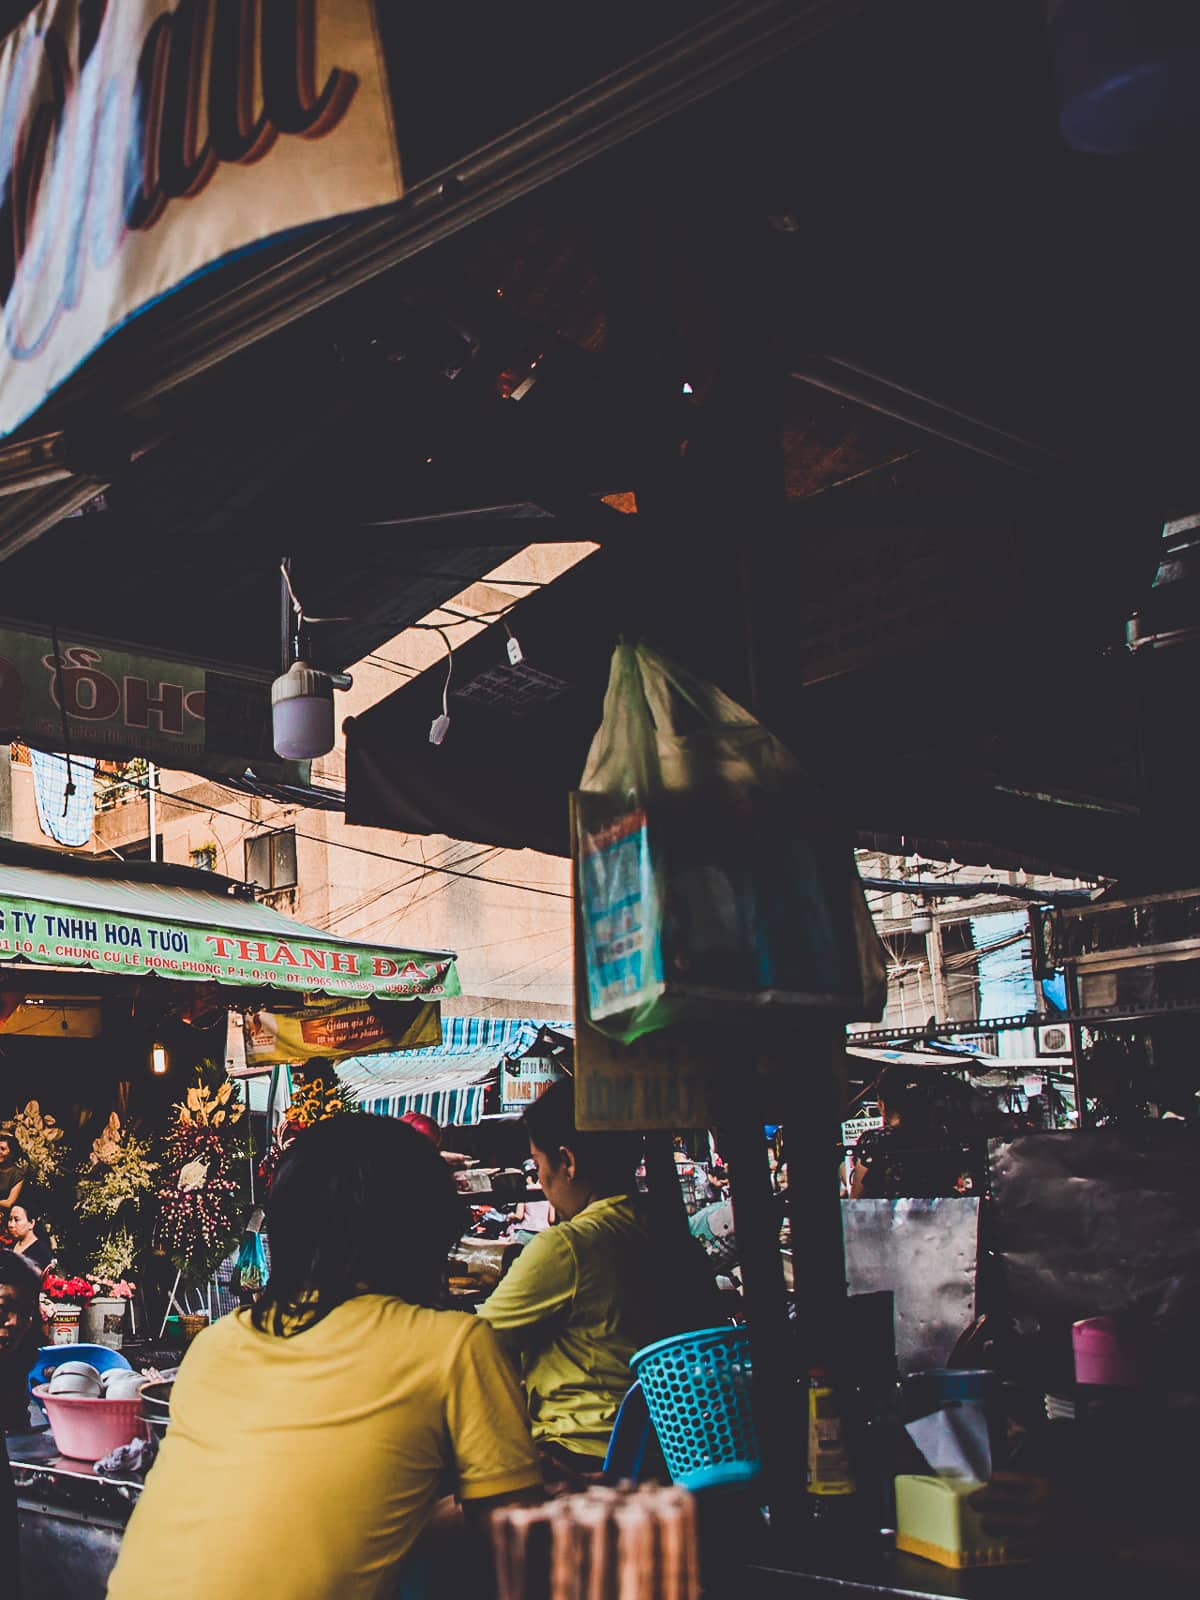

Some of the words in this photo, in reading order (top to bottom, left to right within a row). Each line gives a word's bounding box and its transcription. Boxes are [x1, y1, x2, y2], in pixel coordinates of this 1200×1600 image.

[11, 911, 37, 934] TY
[44, 915, 97, 941] TNHH
[104, 923, 142, 948] HOA
[148, 928, 189, 953] TƯƠI
[206, 935, 360, 974] THÀNH
[16, 940, 33, 953] LÔ
[55, 945, 99, 960] CHUNG
[182, 960, 224, 976] PHONG,
